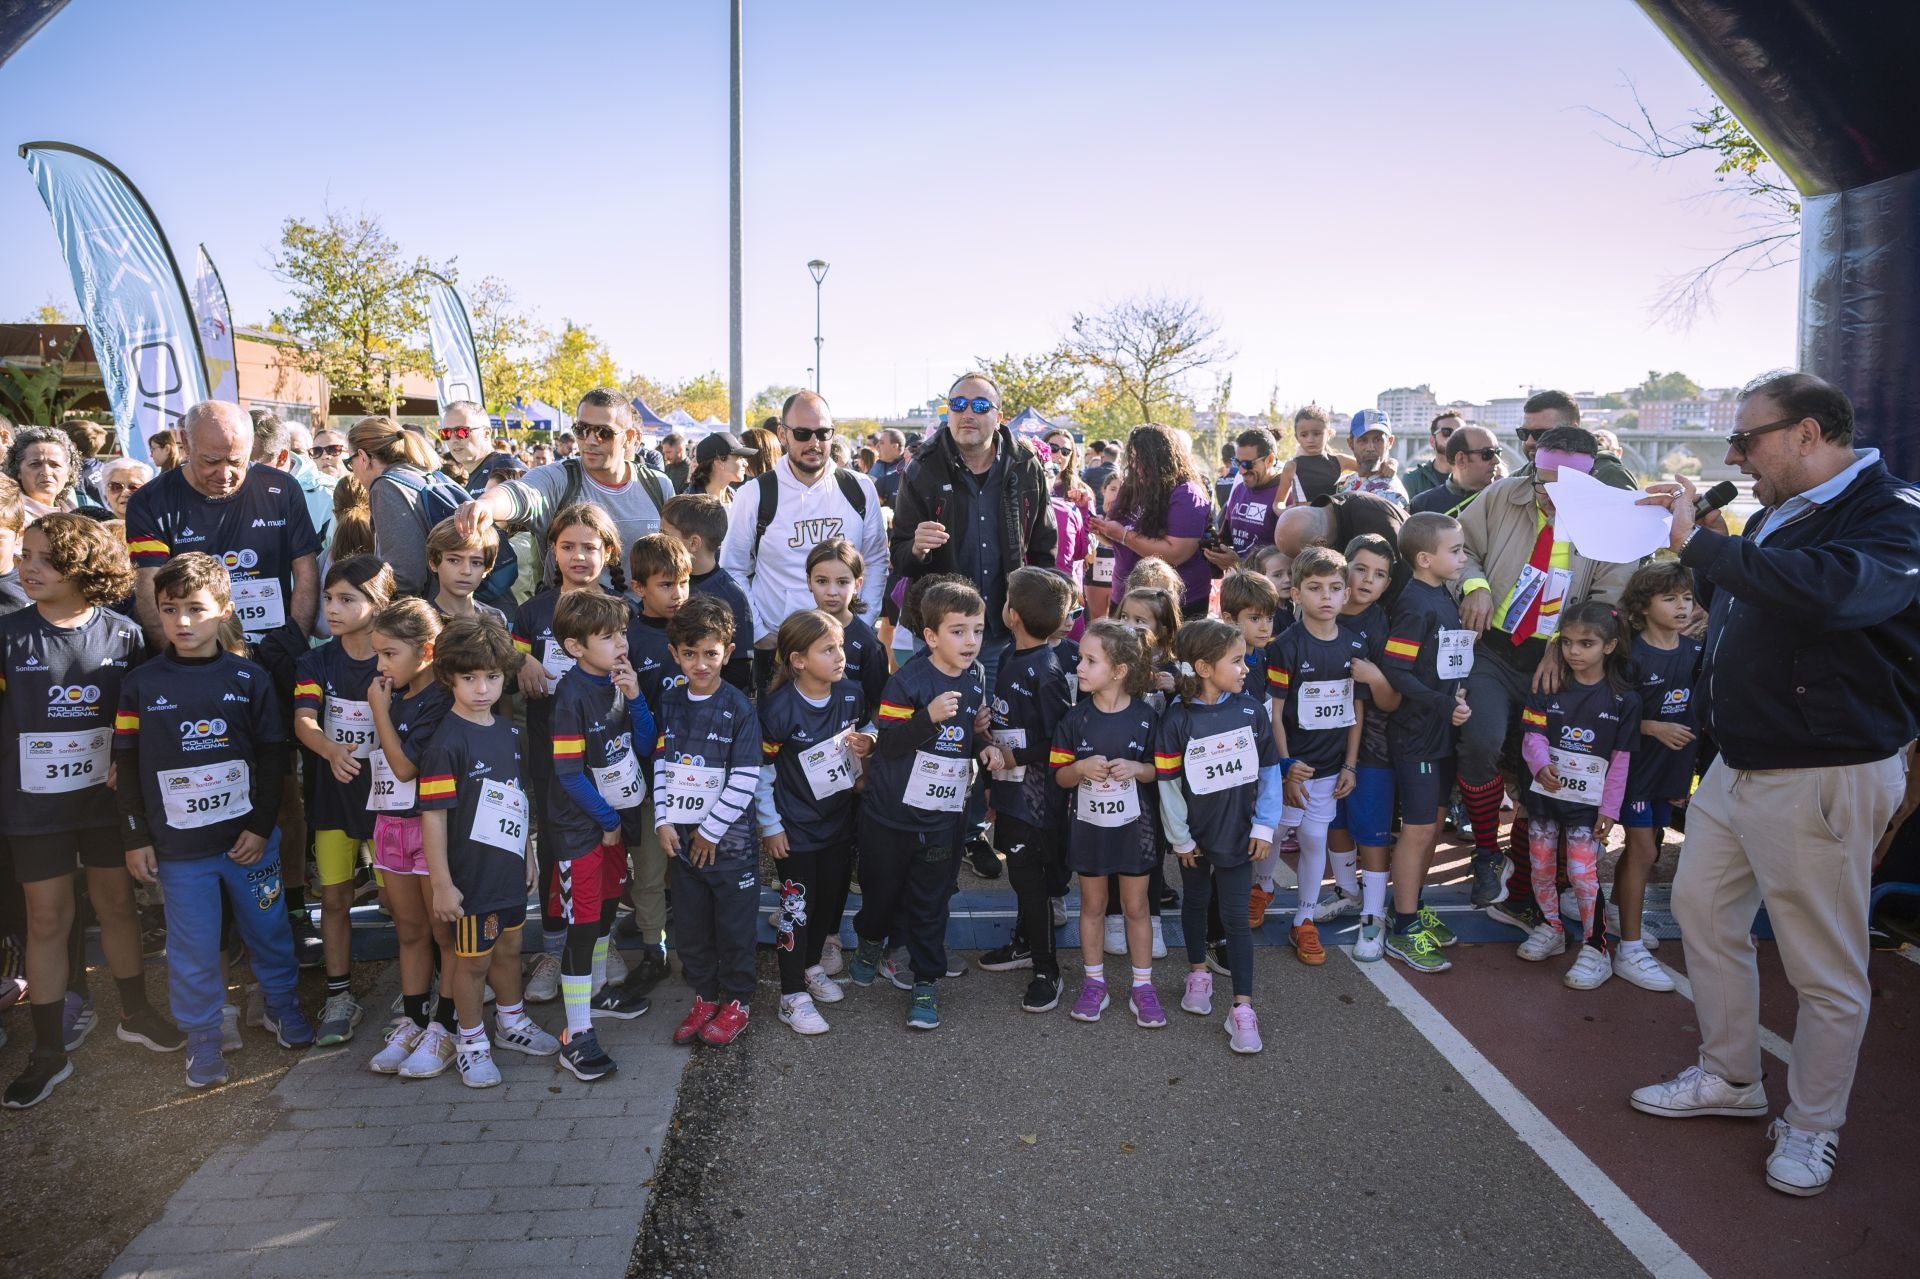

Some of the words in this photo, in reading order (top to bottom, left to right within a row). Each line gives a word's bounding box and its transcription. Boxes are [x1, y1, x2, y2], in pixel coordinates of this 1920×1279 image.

[788, 517, 845, 548] JVZ
[237, 606, 266, 621] 159
[16, 663, 49, 673] Santander
[48, 685, 101, 705] 200
[147, 703, 178, 712] Santander
[1314, 704, 1344, 718] 3073
[179, 718, 228, 740] 200
[335, 728, 375, 745] 3031
[1561, 725, 1596, 743] 200
[181, 738, 220, 747] POLICIA
[182, 743, 230, 752] NACIONAL
[46, 759, 93, 779] 3126
[1204, 758, 1243, 780] 3144
[925, 783, 957, 799] 3054
[1560, 776, 1588, 792] 088
[186, 792, 231, 814] 3037
[665, 793, 705, 811] 3109
[1089, 800, 1126, 815] 3120
[498, 818, 522, 839] 126
